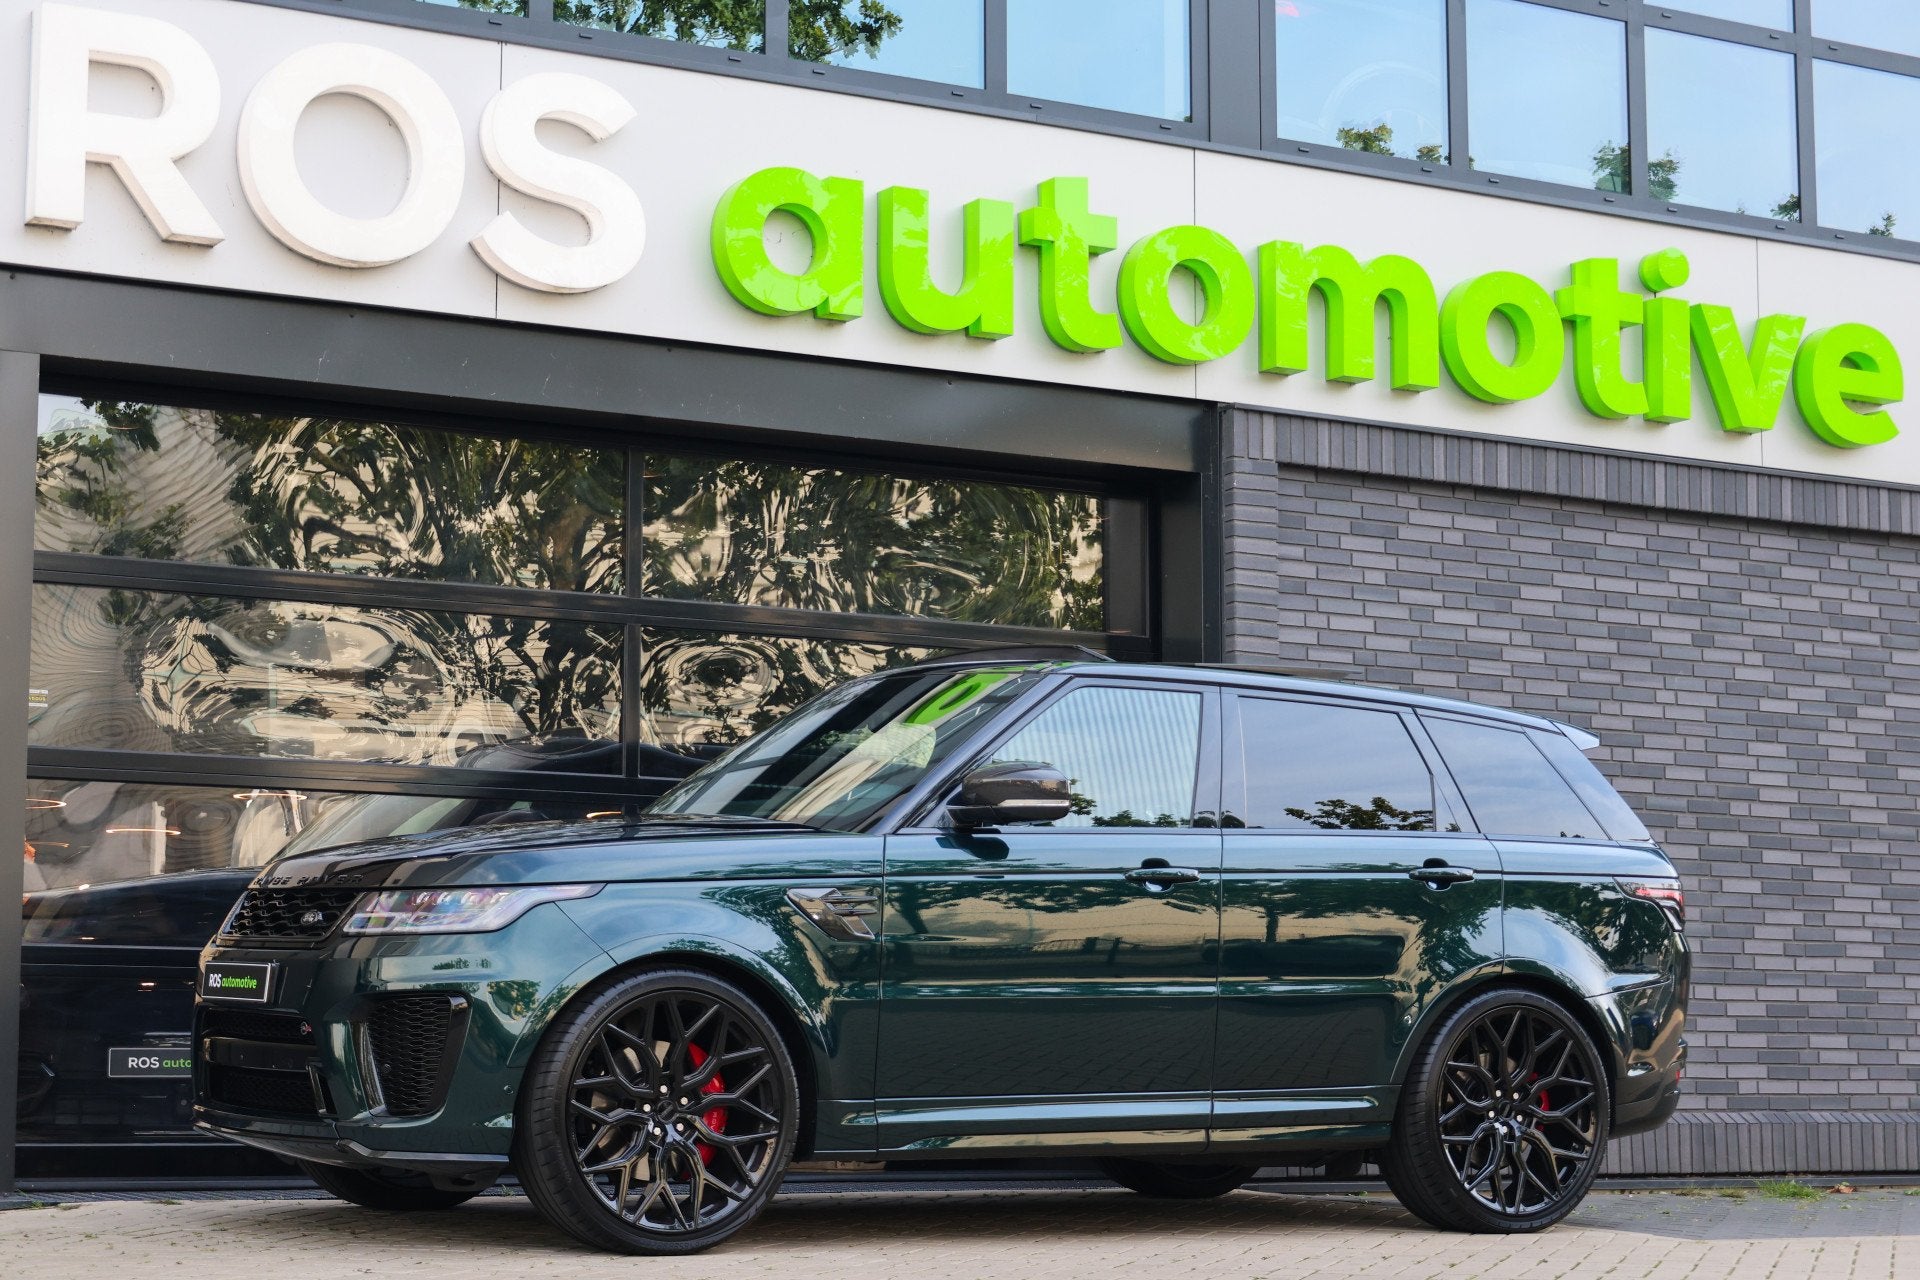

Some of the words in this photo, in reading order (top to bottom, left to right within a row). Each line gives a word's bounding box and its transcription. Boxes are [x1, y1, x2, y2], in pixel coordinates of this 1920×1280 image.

[25, 2, 646, 295] ROS
[711, 166, 1904, 449] automotive
[208, 973, 222, 988] ROS
[222, 976, 258, 989] automotive
[128, 1056, 160, 1069] ROS
